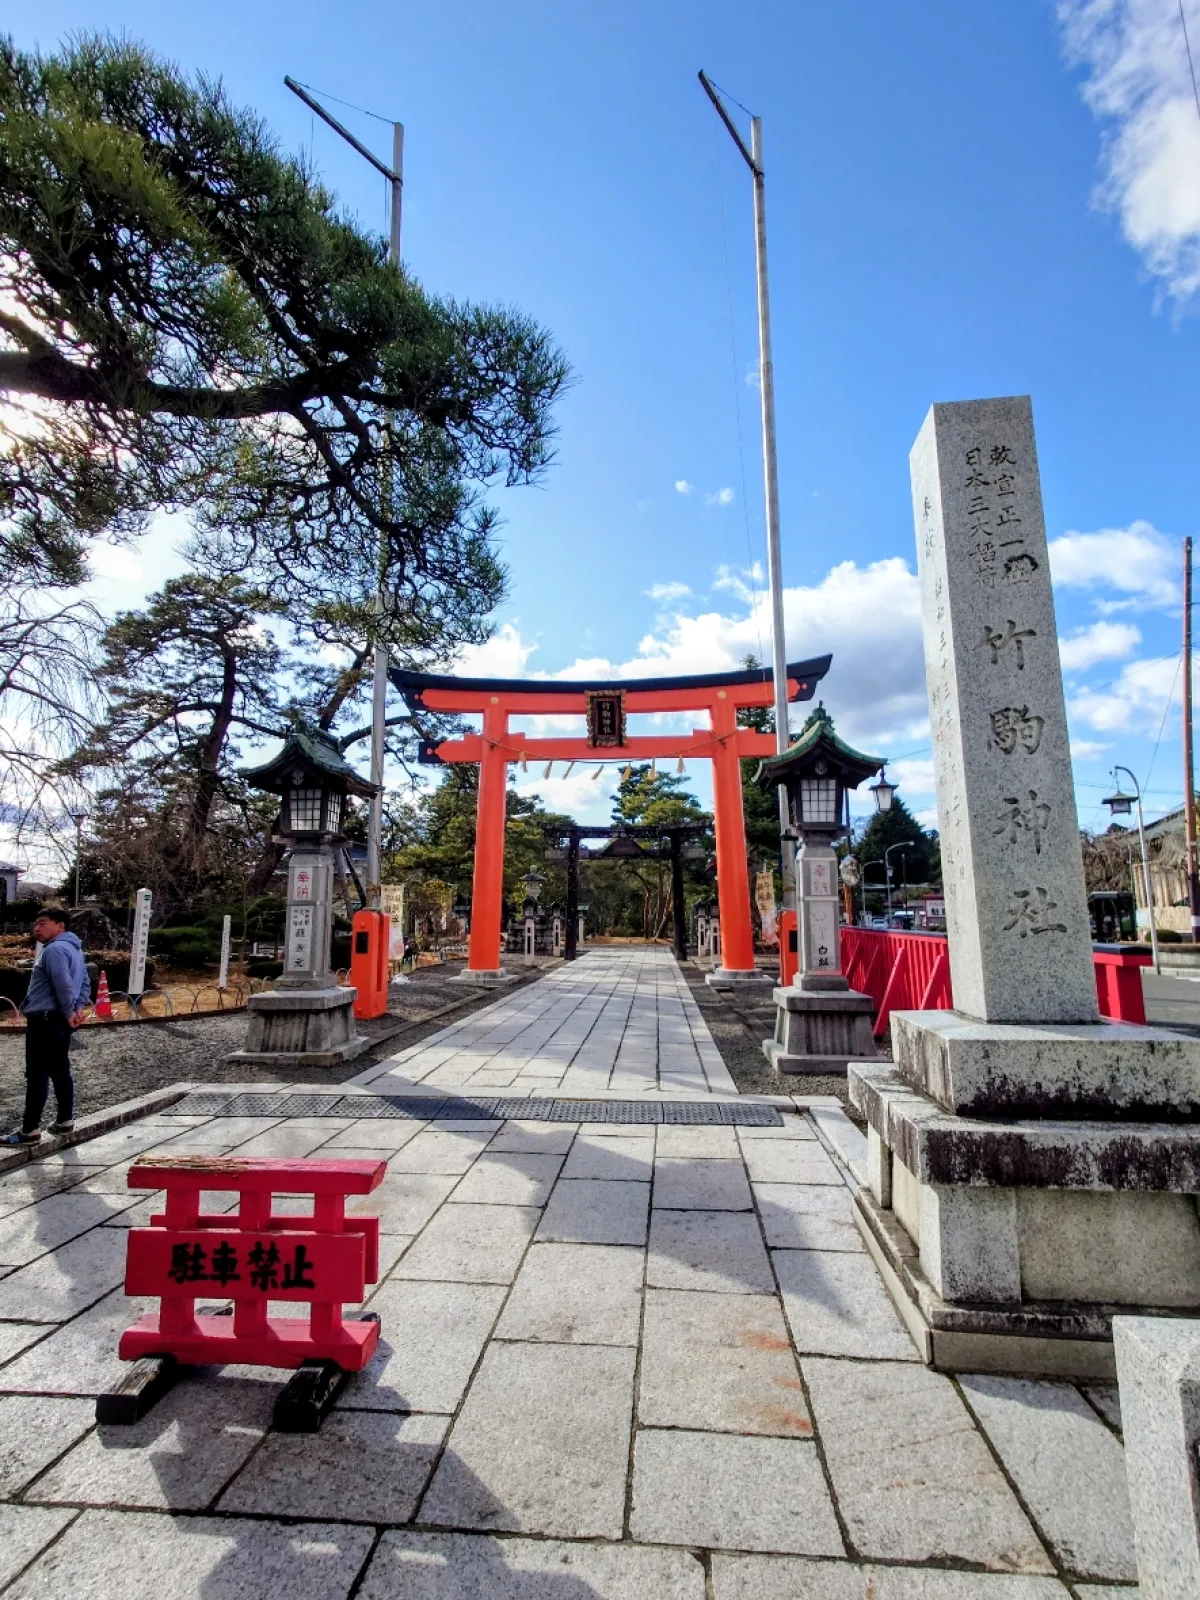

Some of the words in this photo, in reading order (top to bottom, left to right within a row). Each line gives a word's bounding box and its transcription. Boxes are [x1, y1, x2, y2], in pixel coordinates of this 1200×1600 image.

[602, 701, 612, 735] 竹駒神社
[973, 619, 1068, 939] 竹駒神社
[167, 1240, 316, 1292] 駐車禁止
